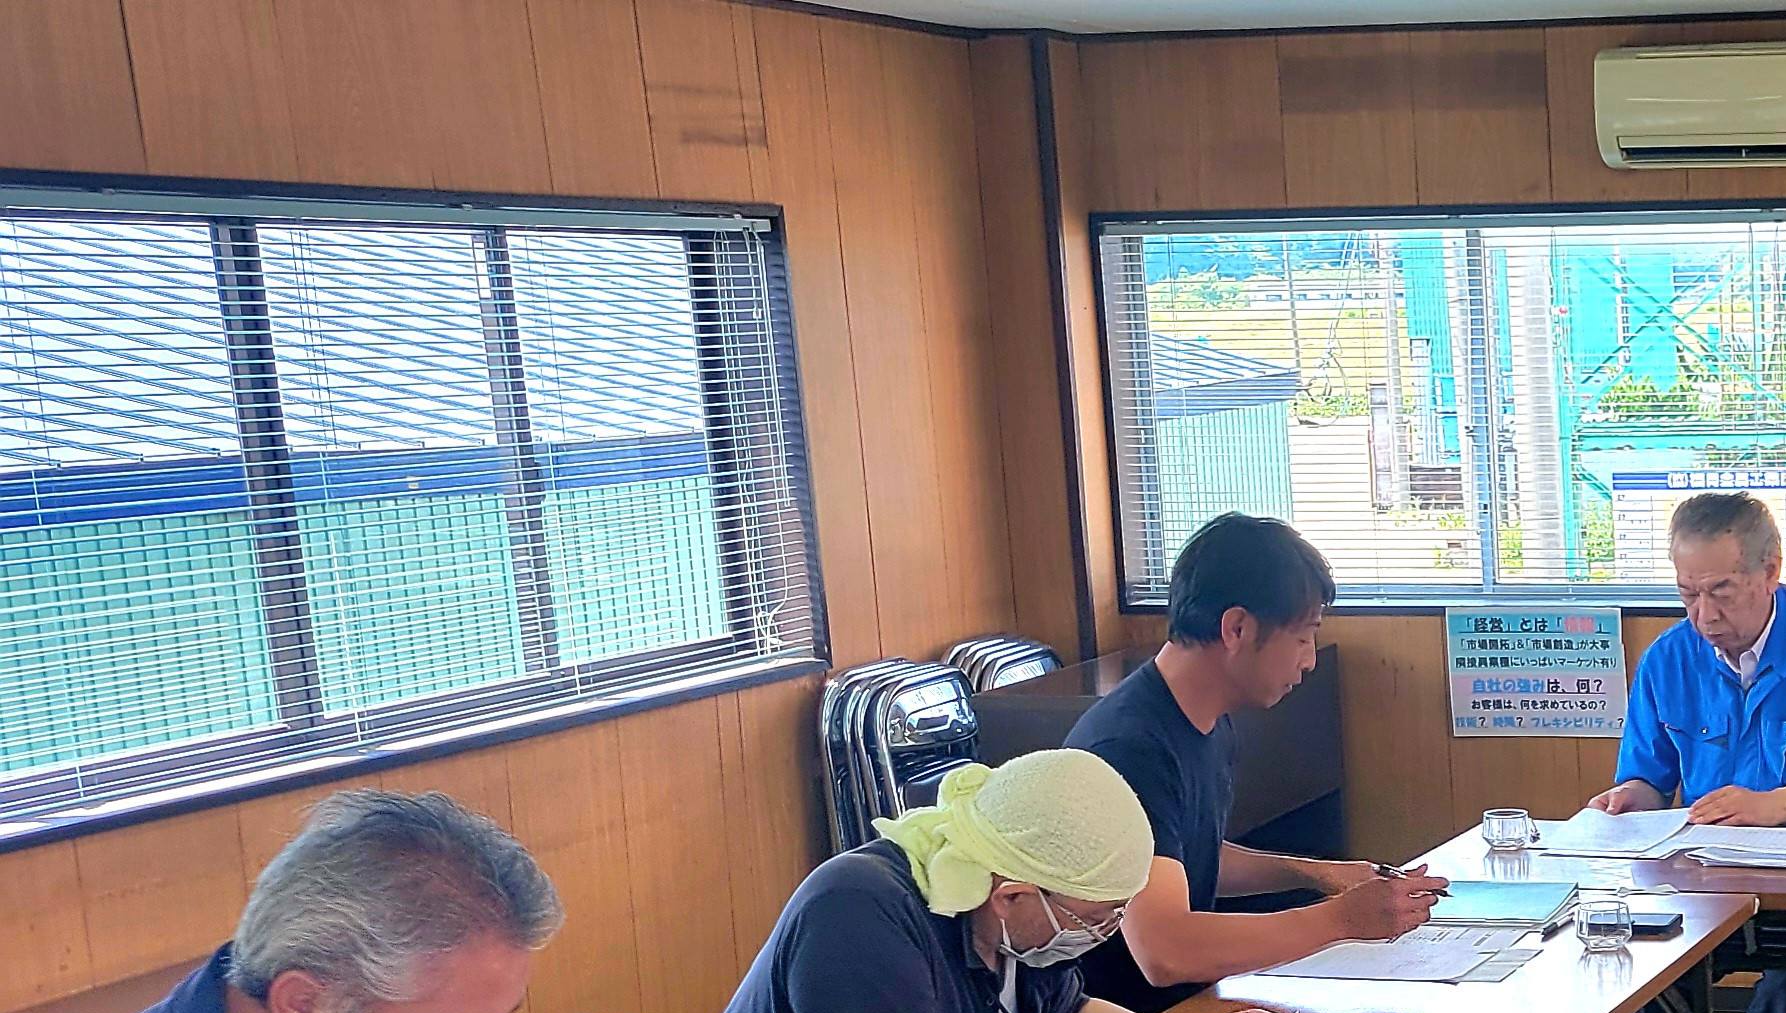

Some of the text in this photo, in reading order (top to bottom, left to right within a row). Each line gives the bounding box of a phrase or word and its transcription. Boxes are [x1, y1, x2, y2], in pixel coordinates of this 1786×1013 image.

[1471, 699, 1607, 711] お客様は、何を求めているの？
